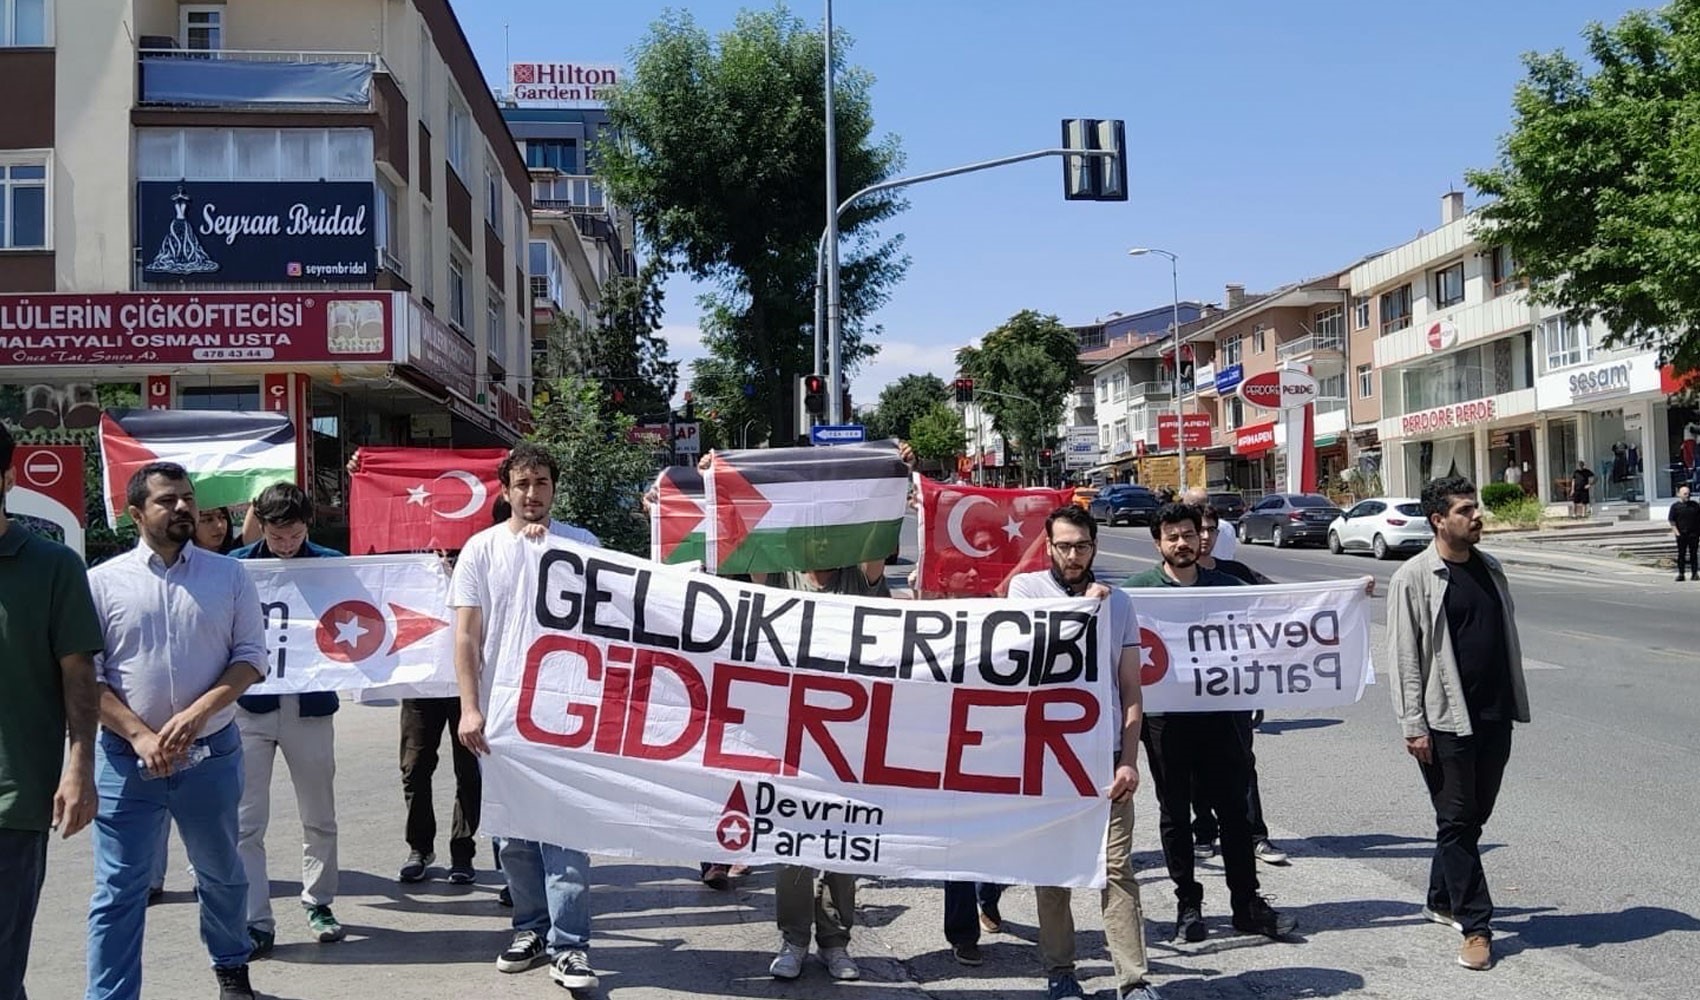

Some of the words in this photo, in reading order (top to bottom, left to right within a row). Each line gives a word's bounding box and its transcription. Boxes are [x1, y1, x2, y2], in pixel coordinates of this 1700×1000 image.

[537, 64, 616, 84] Hilton
[515, 85, 580, 100] Garden
[200, 203, 281, 245] Seyran
[286, 203, 366, 236] Bridal
[305, 262, 367, 276] seyranbridal
[131, 334, 220, 347] OSMAN
[229, 333, 291, 346] USTA
[13, 351, 47, 362] Önce
[88, 351, 133, 363] Sonra
[228, 350, 242, 358] 43
[247, 350, 261, 358] 44
[1569, 364, 1628, 393] sesam
[1246, 384, 1280, 396] PERDORE
[1283, 384, 1314, 395] PERDE
[1402, 408, 1453, 433] PERDORE
[1455, 399, 1496, 422] PERDE
[515, 634, 1101, 798] GİDERLER
[755, 781, 884, 826] Devrim
[751, 817, 880, 863] Partisi
